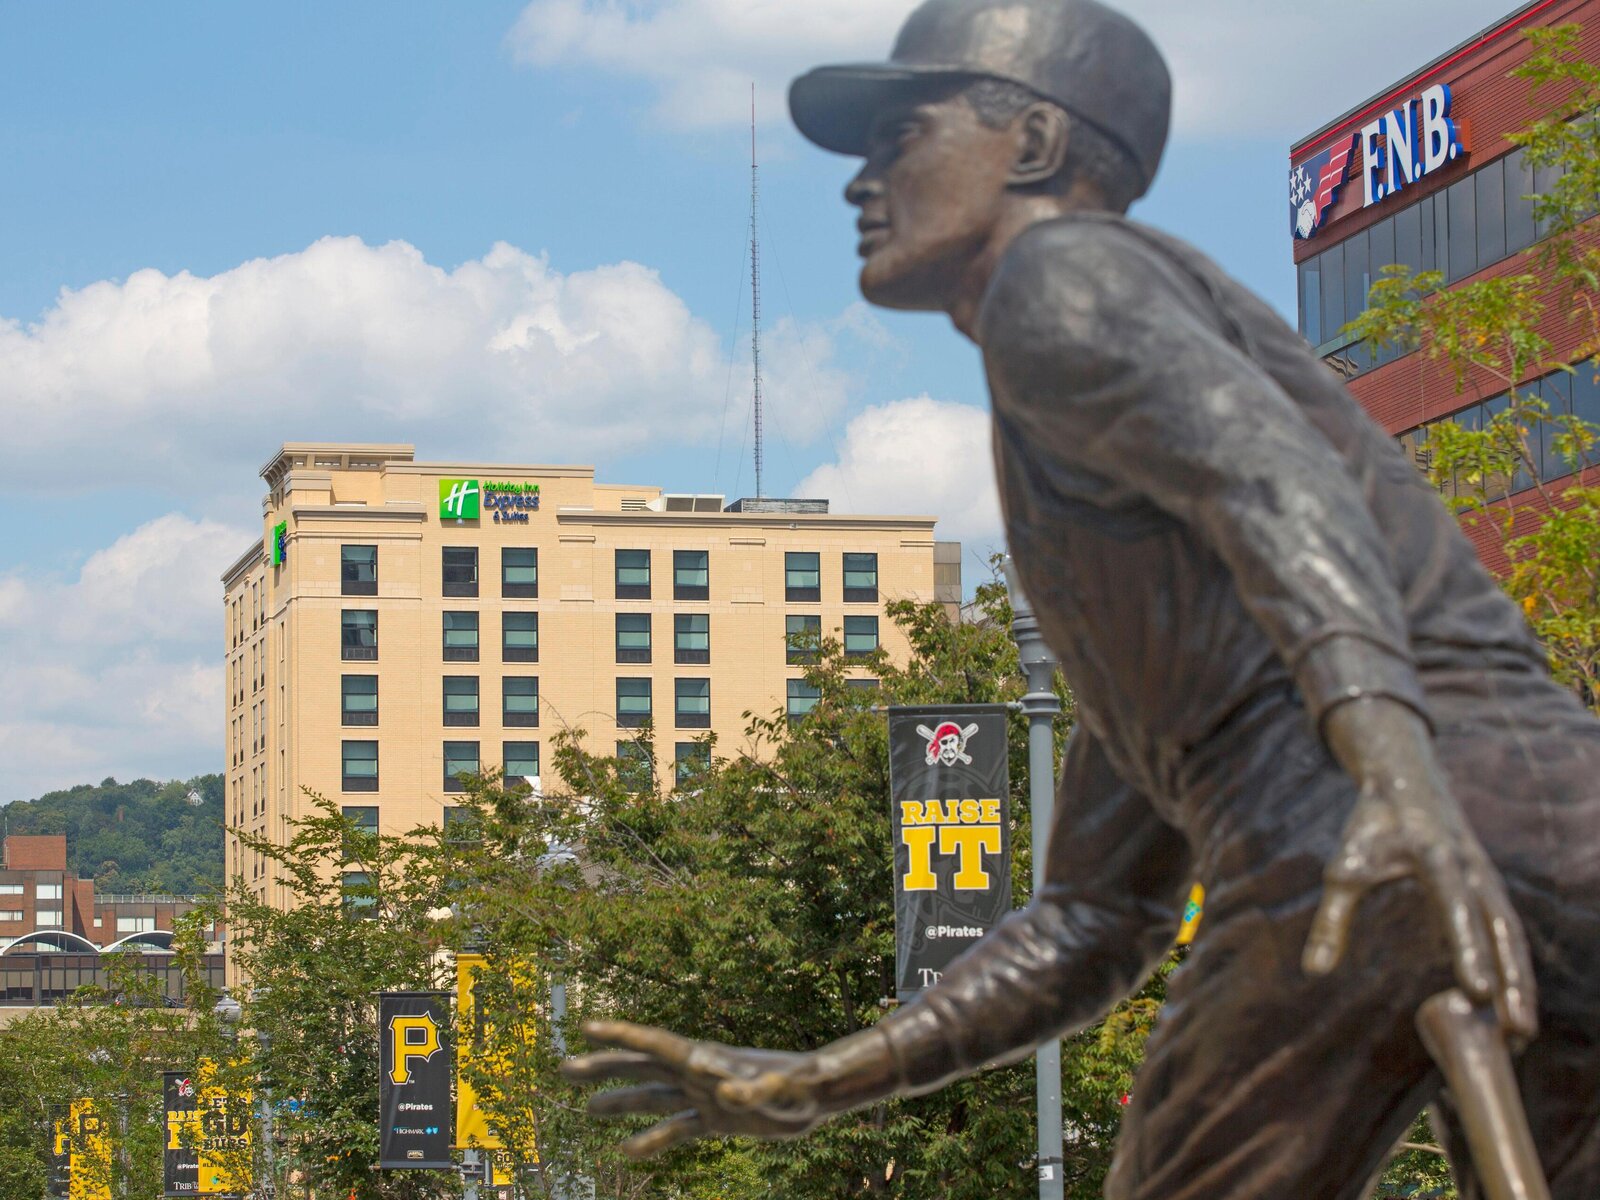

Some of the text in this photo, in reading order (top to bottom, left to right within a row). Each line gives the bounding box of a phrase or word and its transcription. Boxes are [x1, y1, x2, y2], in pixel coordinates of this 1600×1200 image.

[1361, 84, 1460, 208] F.N.B.
[483, 481, 539, 494] Holiday Inn
[484, 491, 540, 509] Express
[493, 510, 529, 521] & Suites
[900, 798, 1001, 825] RAISE
[902, 825, 1002, 891] IT
[925, 925, 984, 940] @Pirates
[388, 1010, 443, 1085] P
[398, 1102, 433, 1111] @Pirates
